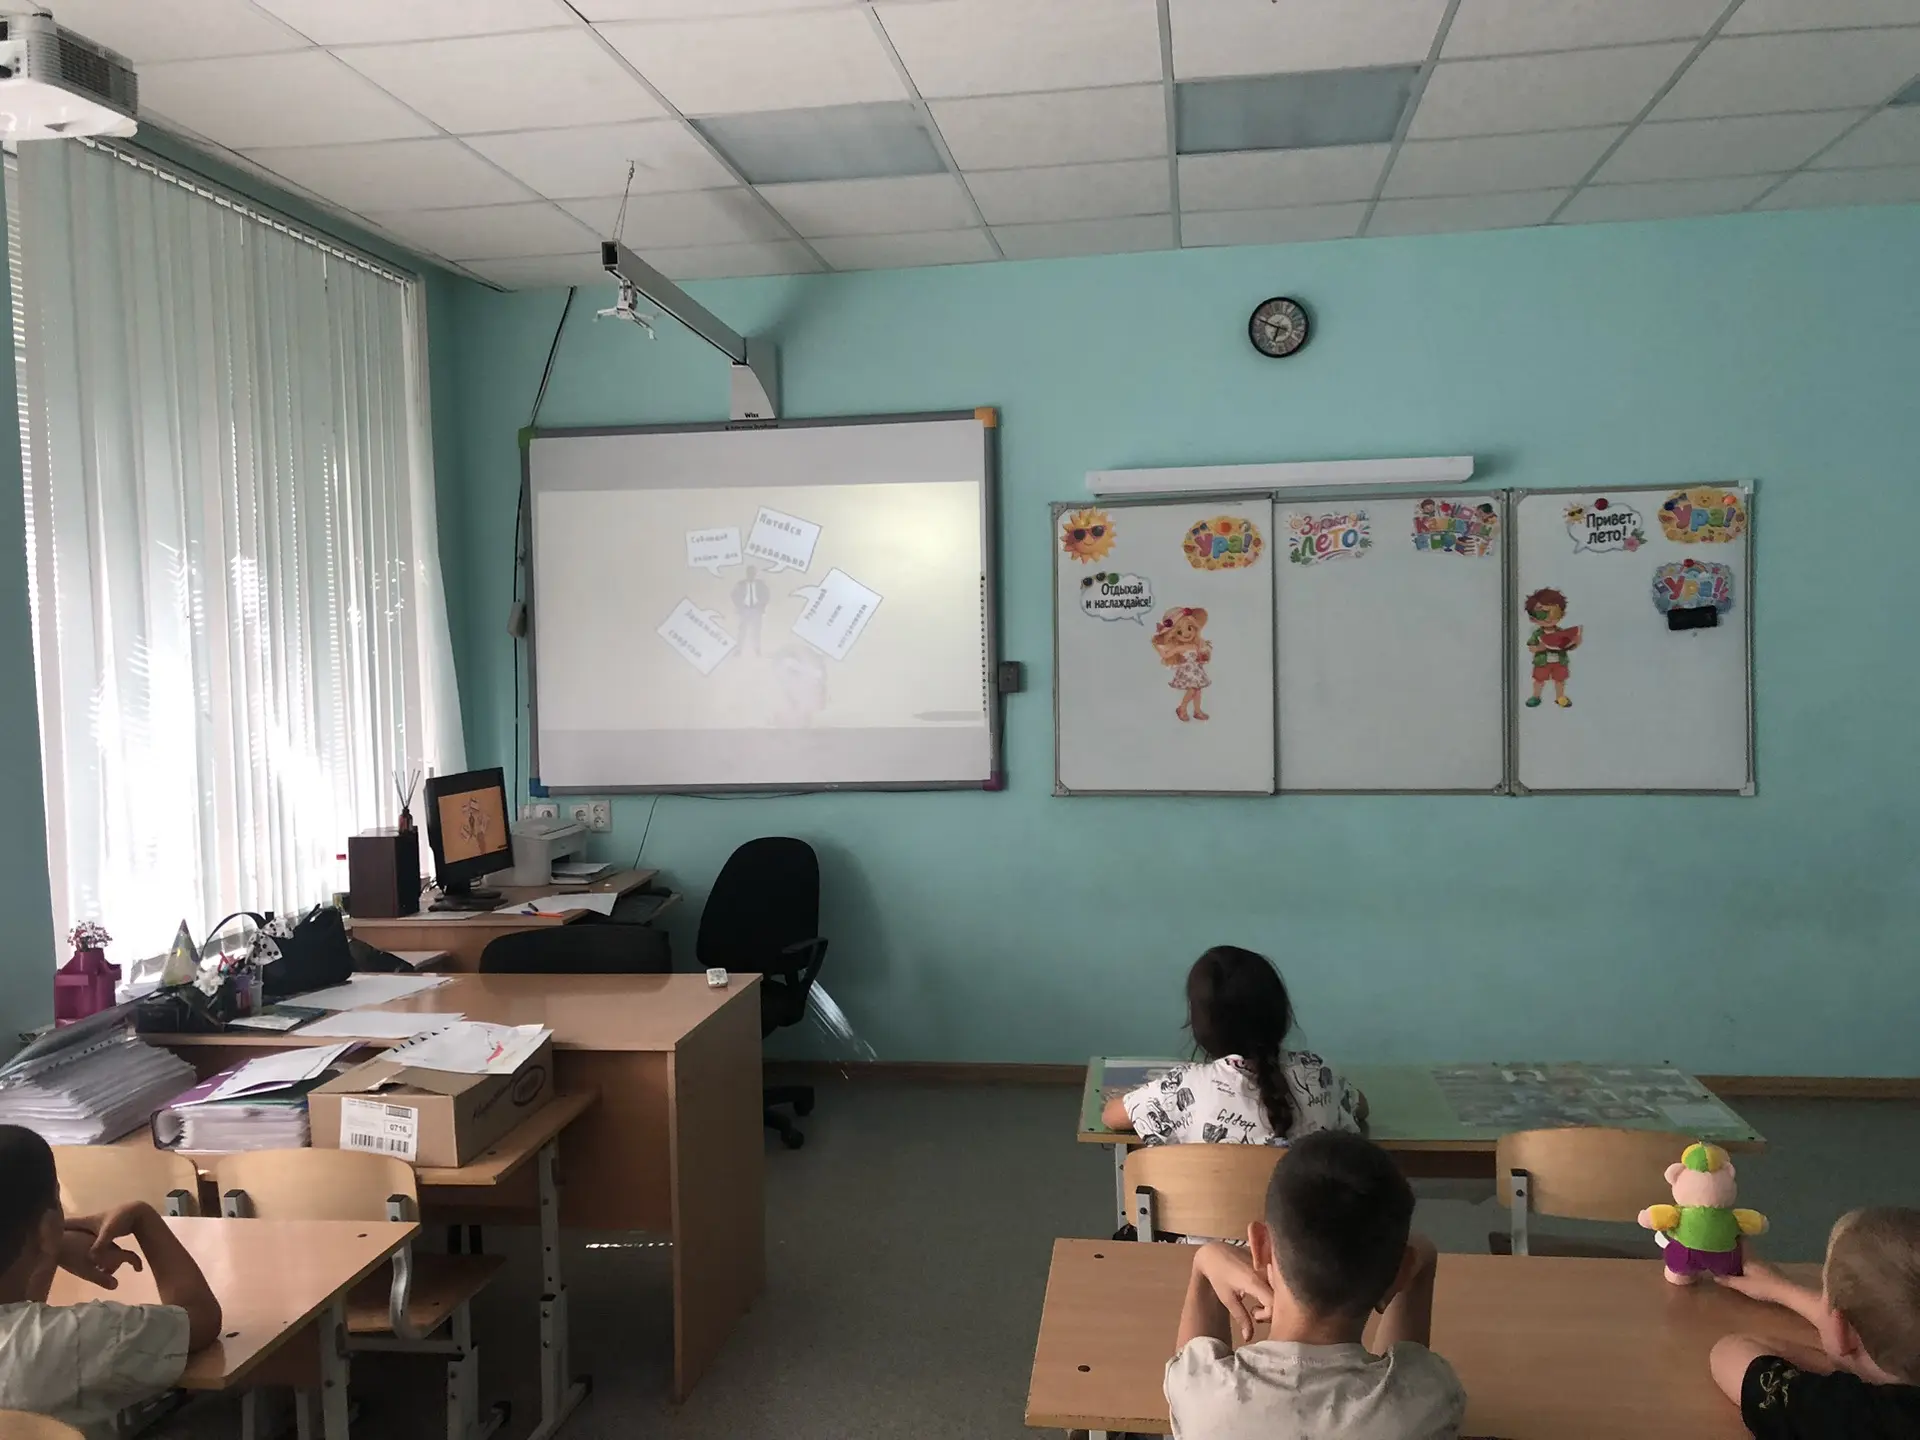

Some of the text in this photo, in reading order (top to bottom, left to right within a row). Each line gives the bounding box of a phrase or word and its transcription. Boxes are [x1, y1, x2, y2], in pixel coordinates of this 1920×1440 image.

[1586, 512, 1636, 531] Привет,
[1672, 504, 1736, 532] Ура!
[1587, 526, 1627, 544] лето!
[1194, 533, 1252, 559] Ура!
[1101, 582, 1144, 596] Отдыхай
[1664, 575, 1724, 601] Ура!
[1086, 596, 1152, 610] и наслаждайся!
[389, 1123, 408, 1133] 0716
[1217, 1108, 1257, 1132] Happy
